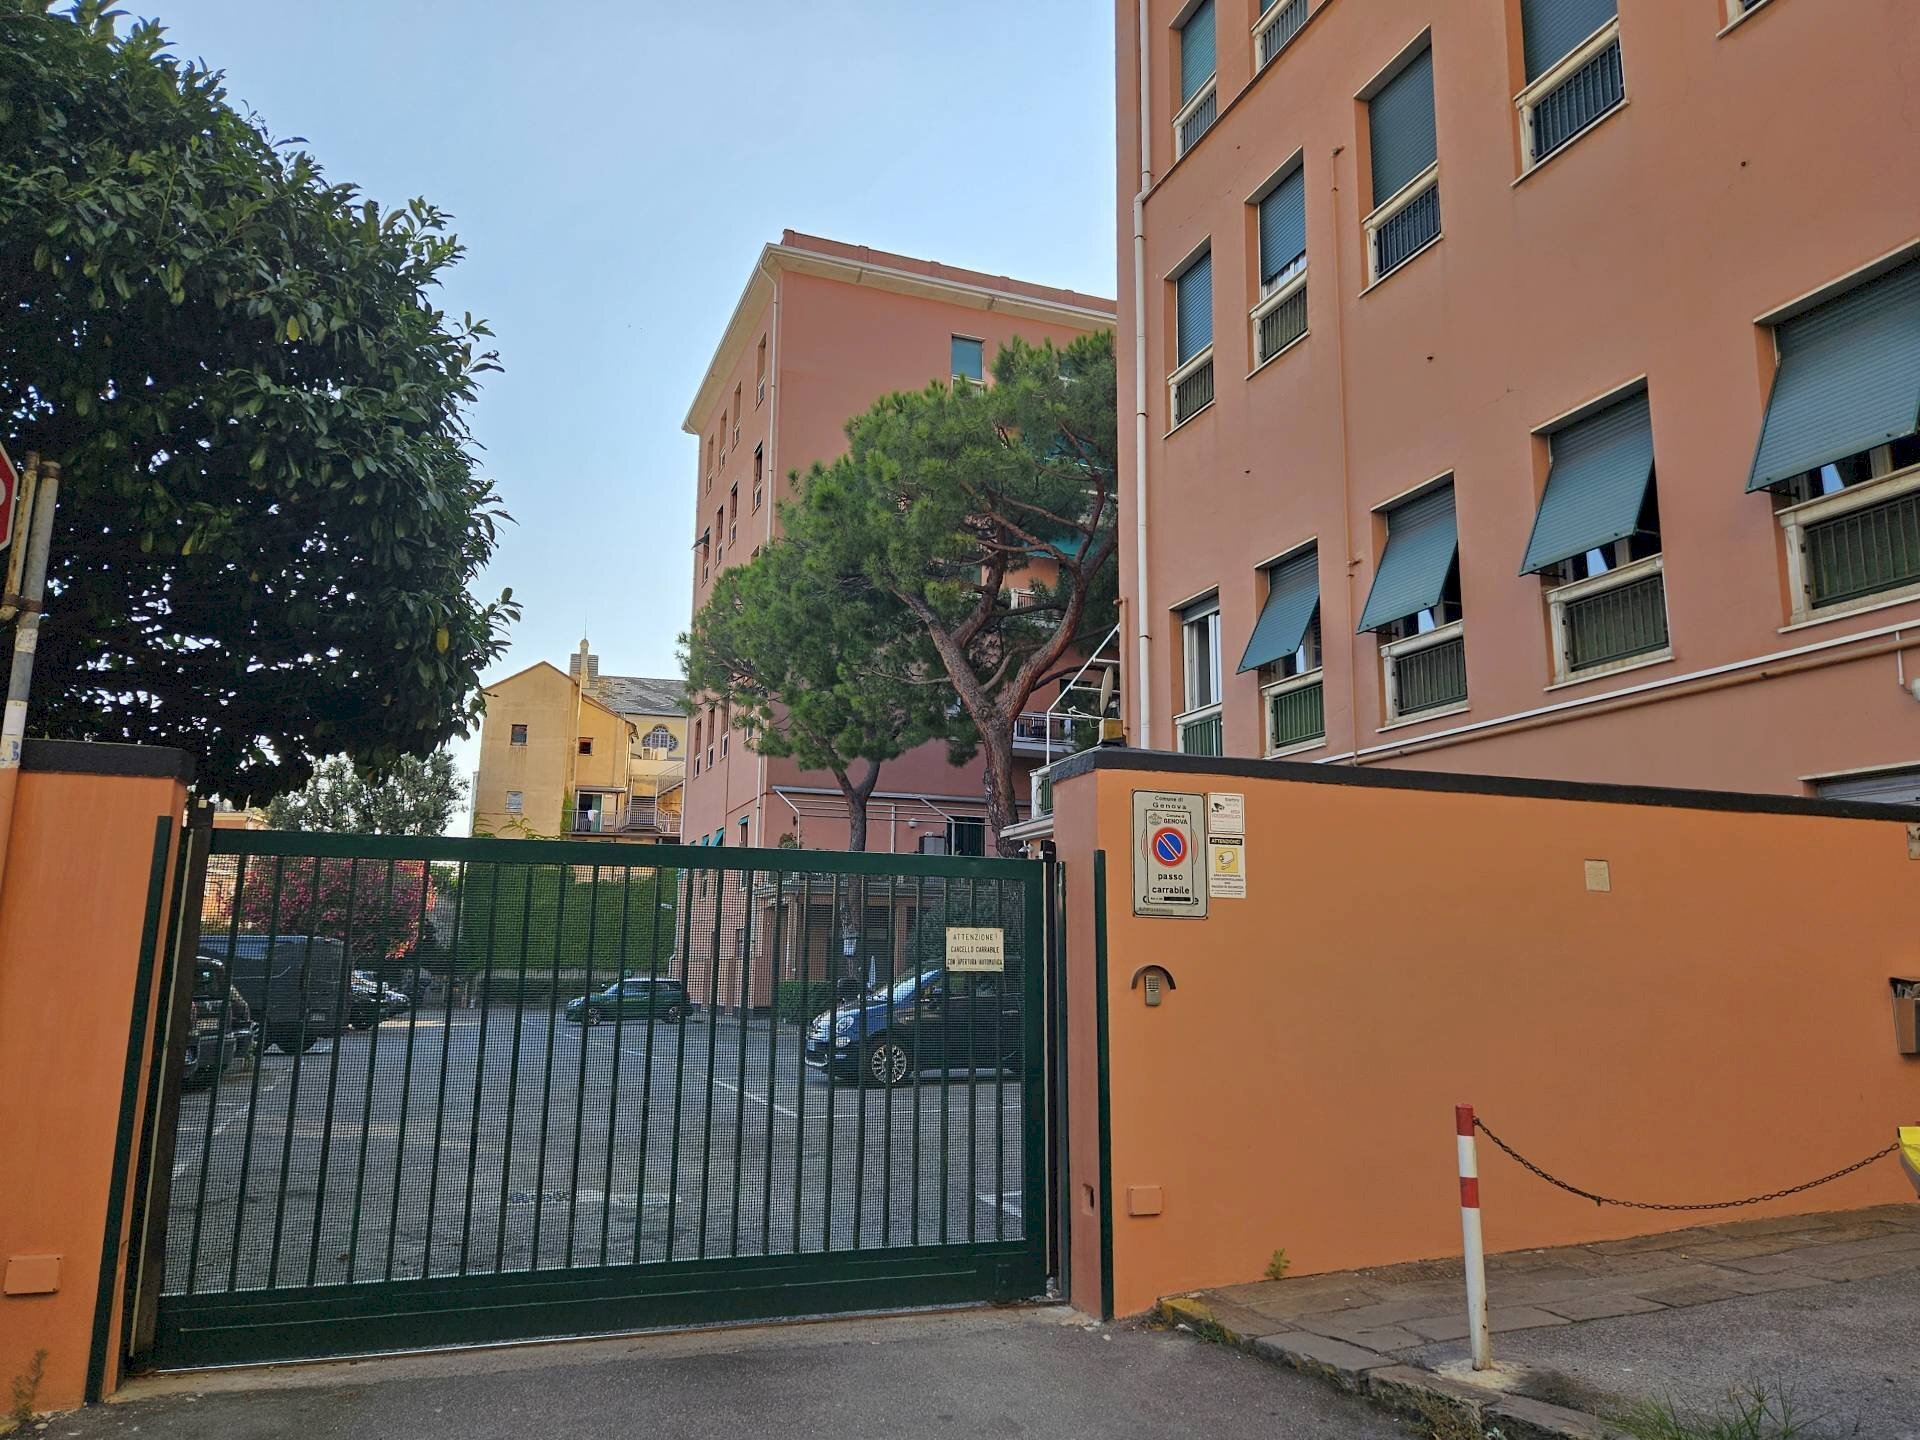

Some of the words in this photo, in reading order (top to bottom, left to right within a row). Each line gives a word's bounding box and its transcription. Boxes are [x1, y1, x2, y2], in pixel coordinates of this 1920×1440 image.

[1152, 801, 1187, 810] Genova
[1157, 873, 1184, 881] passo
[1151, 885, 1190, 895] carrabile
